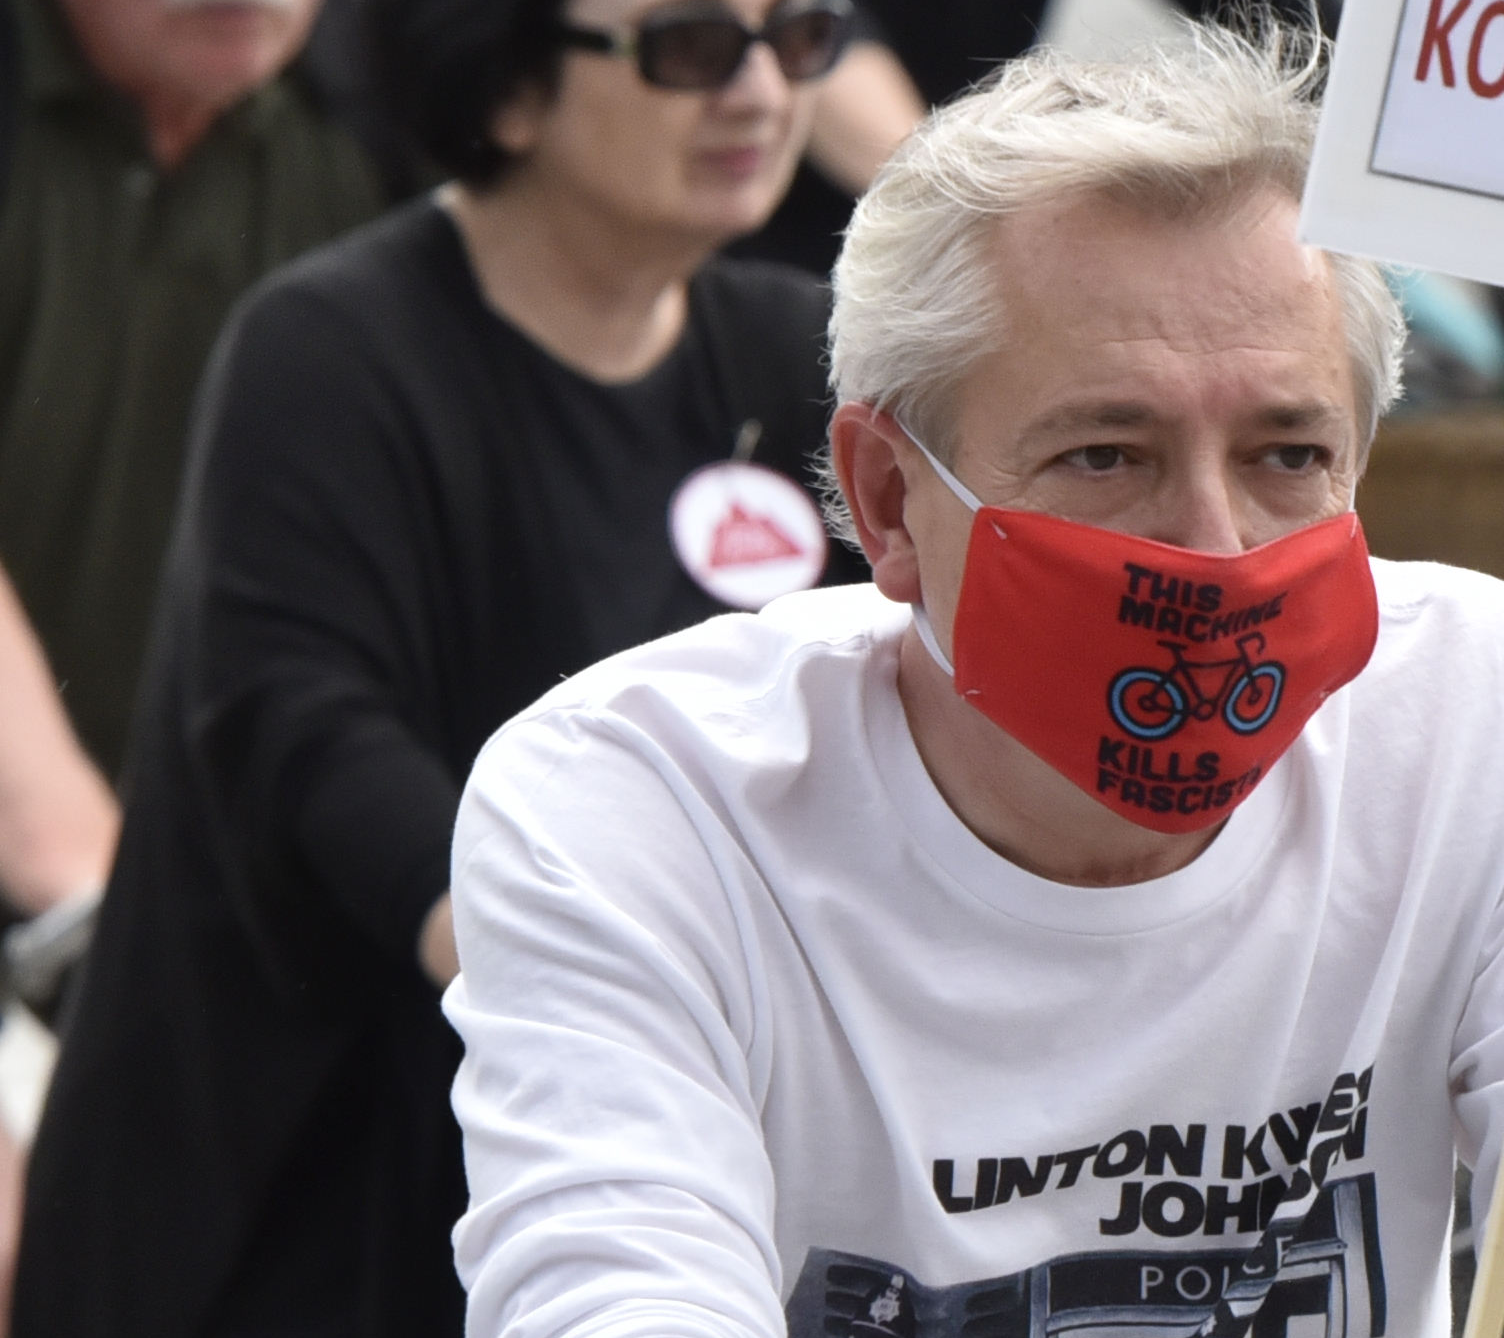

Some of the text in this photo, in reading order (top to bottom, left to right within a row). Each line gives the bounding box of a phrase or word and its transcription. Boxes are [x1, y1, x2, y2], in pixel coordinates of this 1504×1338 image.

[1124, 562, 1223, 611] THIS
[1119, 591, 1288, 642] MACHINE
[1099, 736, 1220, 783] KILLS
[933, 1124, 1207, 1214] LINTON
